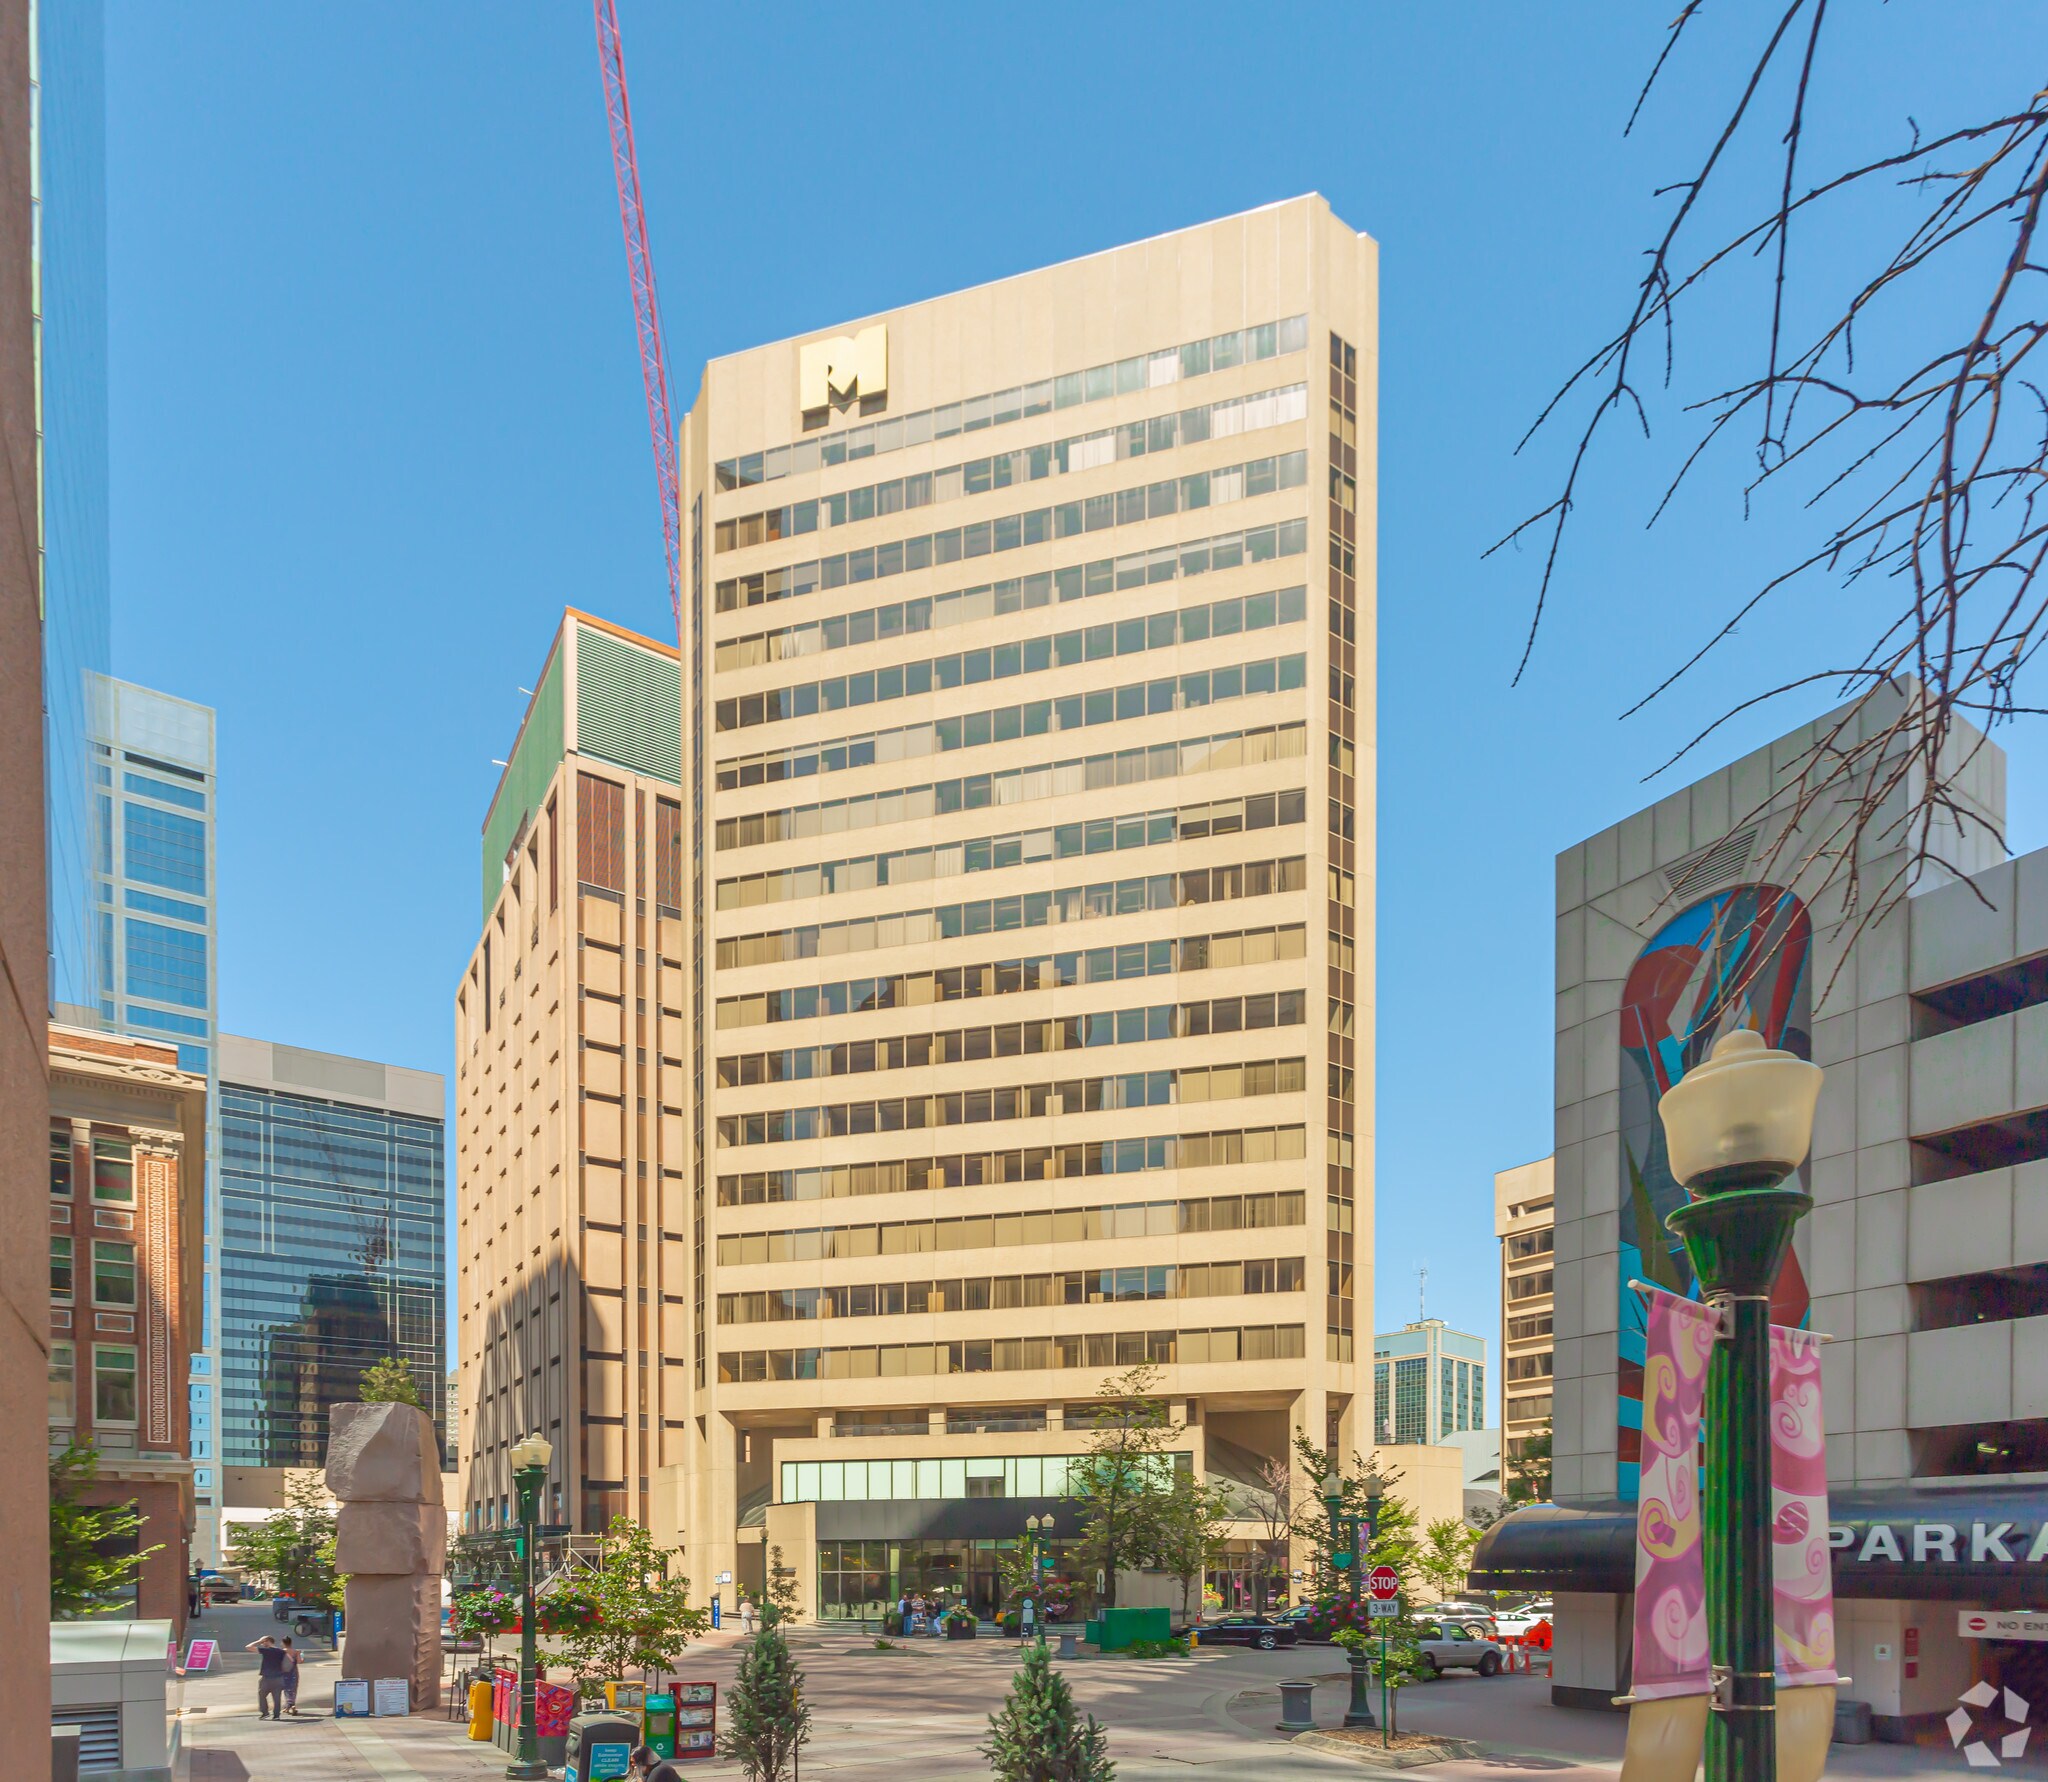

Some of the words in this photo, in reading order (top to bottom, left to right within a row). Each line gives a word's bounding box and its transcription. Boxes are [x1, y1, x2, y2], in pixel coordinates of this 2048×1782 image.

[1371, 1576, 1397, 1590] STOP
[1372, 1603, 1396, 1613] 3-WAY
[1997, 1621, 2019, 1630] NO
